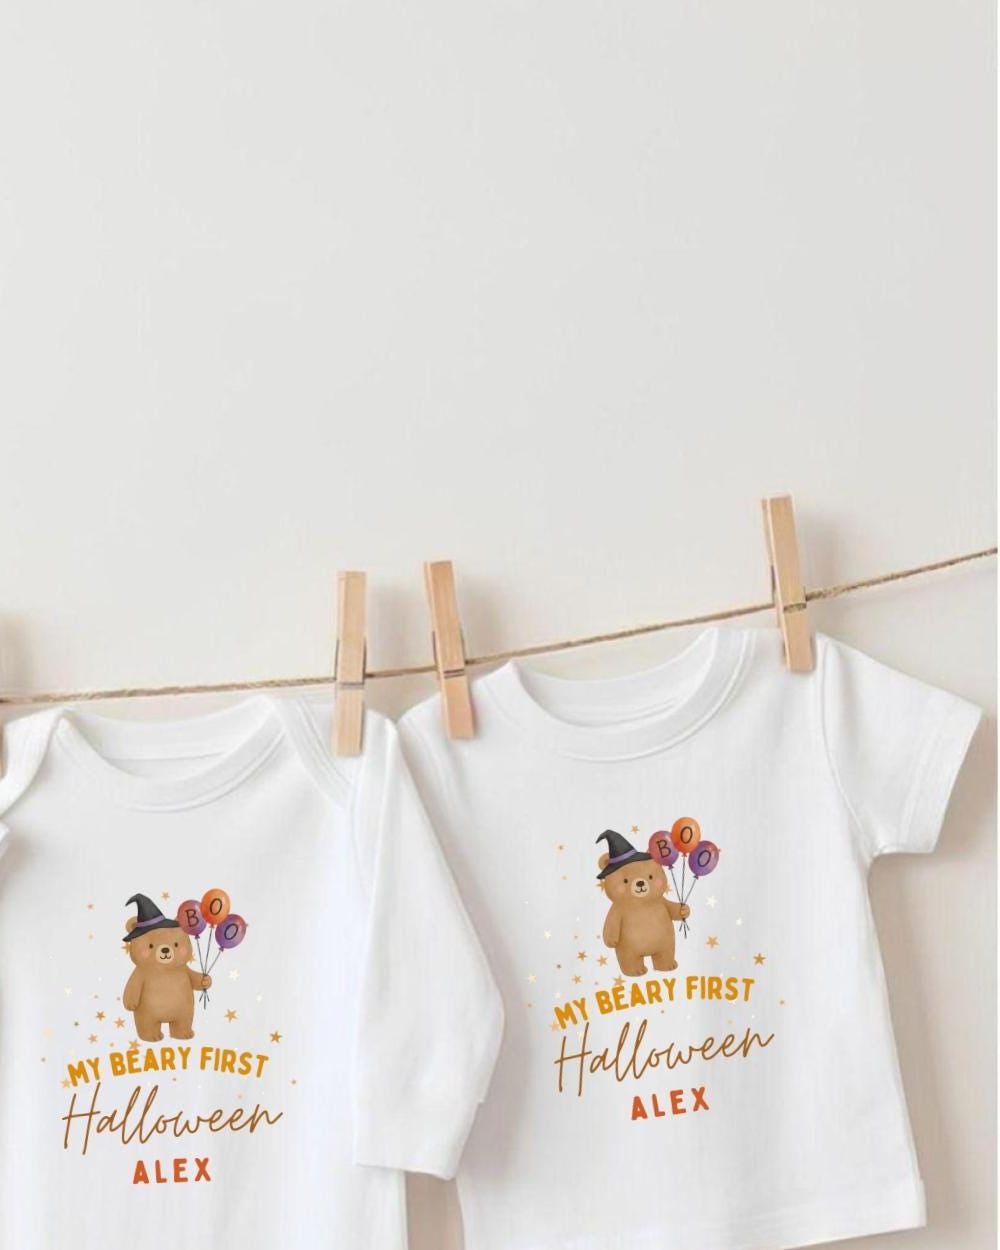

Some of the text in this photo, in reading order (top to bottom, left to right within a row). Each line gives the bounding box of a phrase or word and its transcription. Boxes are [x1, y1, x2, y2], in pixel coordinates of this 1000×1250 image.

[554, 976, 755, 1029] MY BEARY FIRST
[67, 1047, 269, 1086] MY BEARY FIRST
[554, 1019, 774, 1096] Halloween
[62, 1082, 283, 1155] Halloween
[631, 1087, 709, 1120] ALEX
[133, 1157, 211, 1184] ALEX
